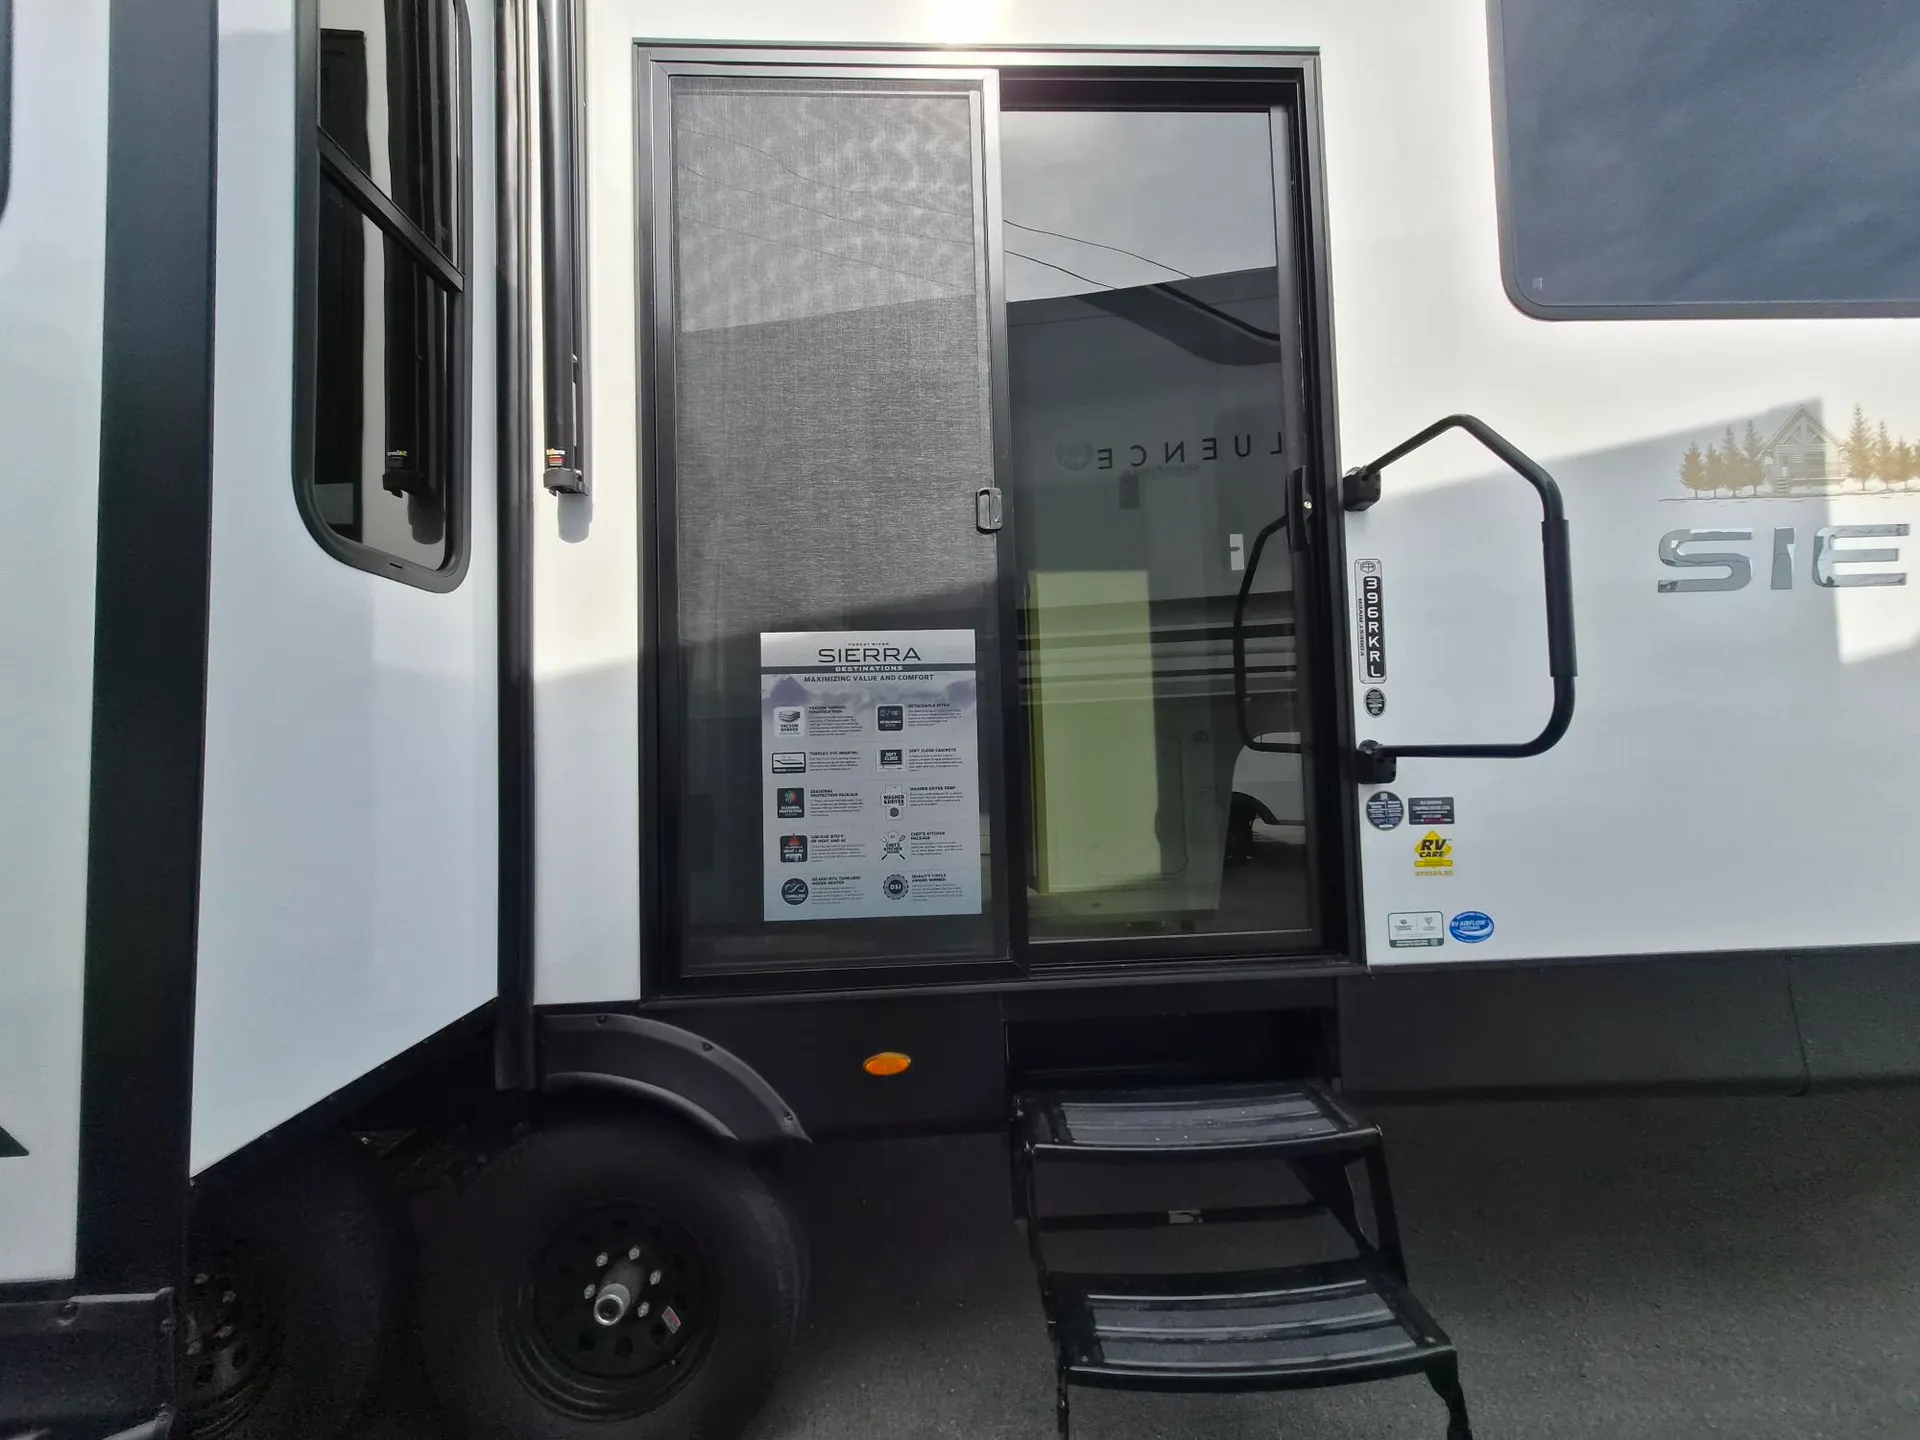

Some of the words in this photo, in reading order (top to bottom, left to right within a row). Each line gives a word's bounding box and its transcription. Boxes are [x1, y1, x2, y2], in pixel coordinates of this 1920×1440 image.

[1657, 523, 1910, 593] SIE
[818, 647, 922, 663] SIERRA
[835, 665, 904, 673] DESTINATIONS
[804, 674, 851, 683] MAXIMIZING
[853, 674, 878, 682] VALUE
[898, 673, 934, 681] COMFORT
[1420, 839, 1447, 851] RV
[1419, 850, 1445, 858] CARE
[1459, 919, 1485, 927] AIRFLOW
